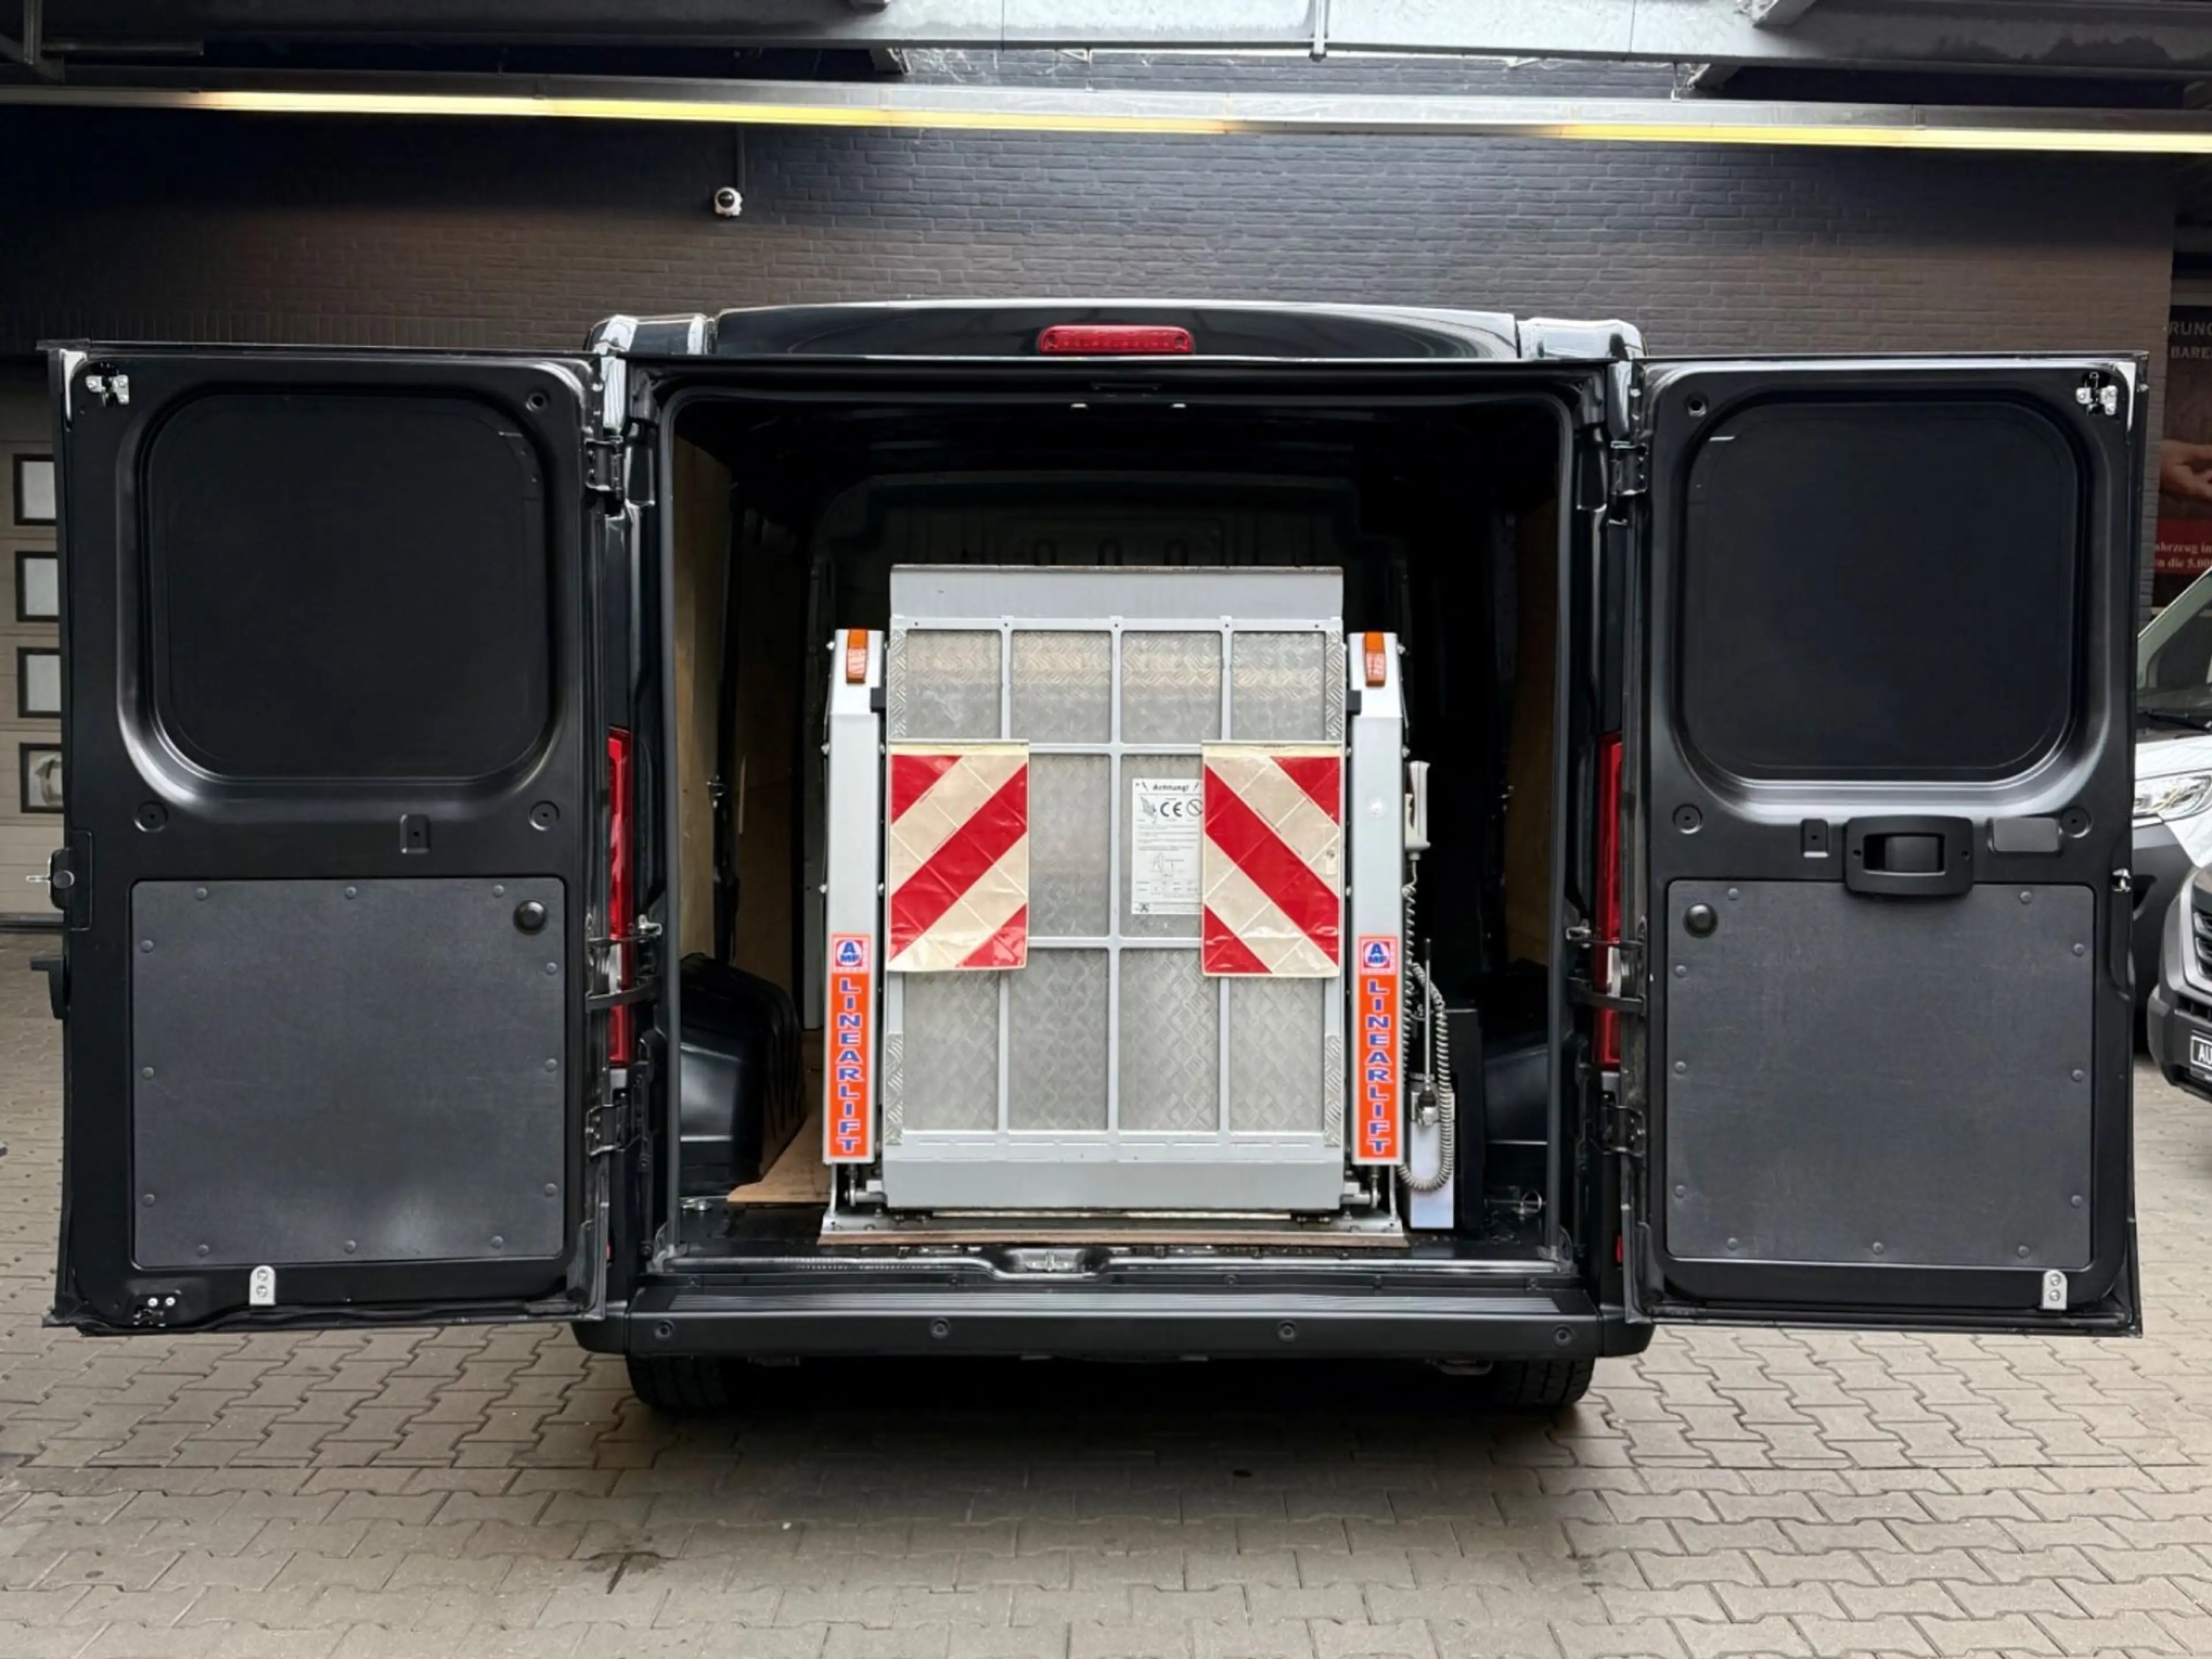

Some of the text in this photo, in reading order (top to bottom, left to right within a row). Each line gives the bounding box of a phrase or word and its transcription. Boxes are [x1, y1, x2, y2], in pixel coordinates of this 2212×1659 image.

[1160, 801, 1183, 817] CE
[837, 979, 862, 1152] LINEARLIFT
[1366, 980, 1391, 1153] LINEARLIFT
